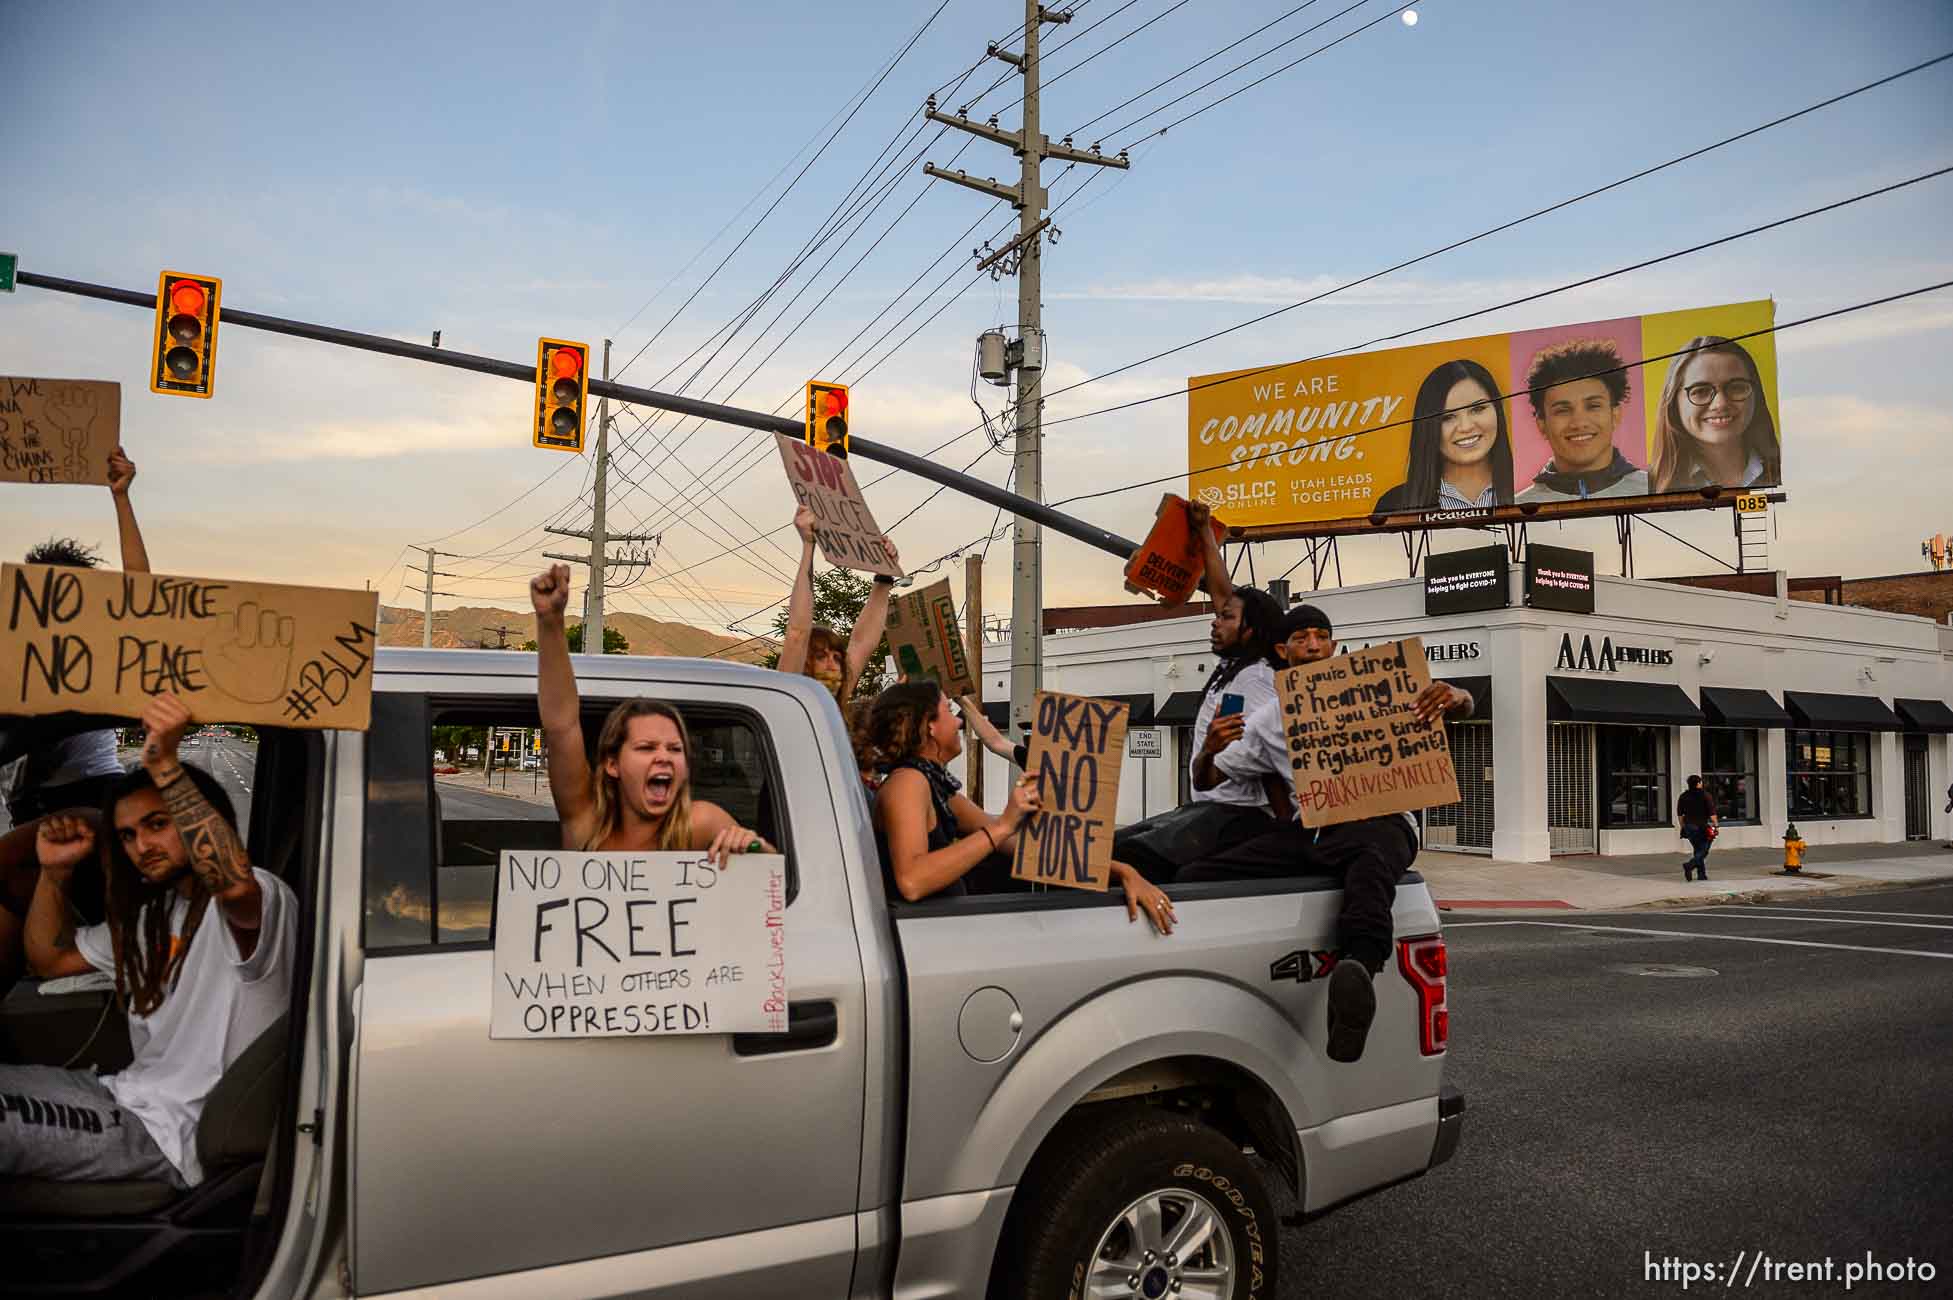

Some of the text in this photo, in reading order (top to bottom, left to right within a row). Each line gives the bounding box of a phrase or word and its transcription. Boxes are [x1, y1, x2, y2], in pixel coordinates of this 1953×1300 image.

[1253, 375, 1339, 400] WE ARE
[1200, 394, 1403, 445] COMMUNITY
[1227, 435, 1365, 471] STRONG.
[1226, 480, 1276, 500] SLCC
[1290, 473, 1373, 490] UTAH LEADS
[1292, 487, 1371, 504] TOGETHER
[794, 483, 878, 536] POLICE
[1739, 496, 1766, 511] 085
[1428, 585, 1449, 594] helping
[1456, 581, 1469, 591] fight
[1469, 579, 1496, 588] COVID-19
[1431, 577, 1448, 585] Thank
[1465, 570, 1495, 580] EVERYONE
[9, 567, 230, 631] NO JUSTICE
[21, 634, 208, 702] NO PEACE
[1349, 640, 1408, 677] tired
[1556, 632, 1673, 672] AAA JEWELERS
[281, 621, 377, 721] #BLM
[1285, 670, 1418, 715] of hearing it
[1038, 694, 1123, 755] OKAY
[1334, 709, 1365, 730] you
[1369, 702, 1411, 719] think
[1136, 740, 1155, 748] STATE
[1292, 752, 1312, 770] of
[1317, 743, 1393, 775] fighting
[1037, 750, 1099, 814] NO
[1015, 810, 1104, 884] MORE
[508, 855, 718, 893] NO ONE IS
[533, 896, 698, 968] FREE
[503, 965, 745, 1000] WHEN OTHERS ARE
[523, 1001, 711, 1033] OPPRESSED!
[1172, 1163, 1264, 1300] GOODYEA
